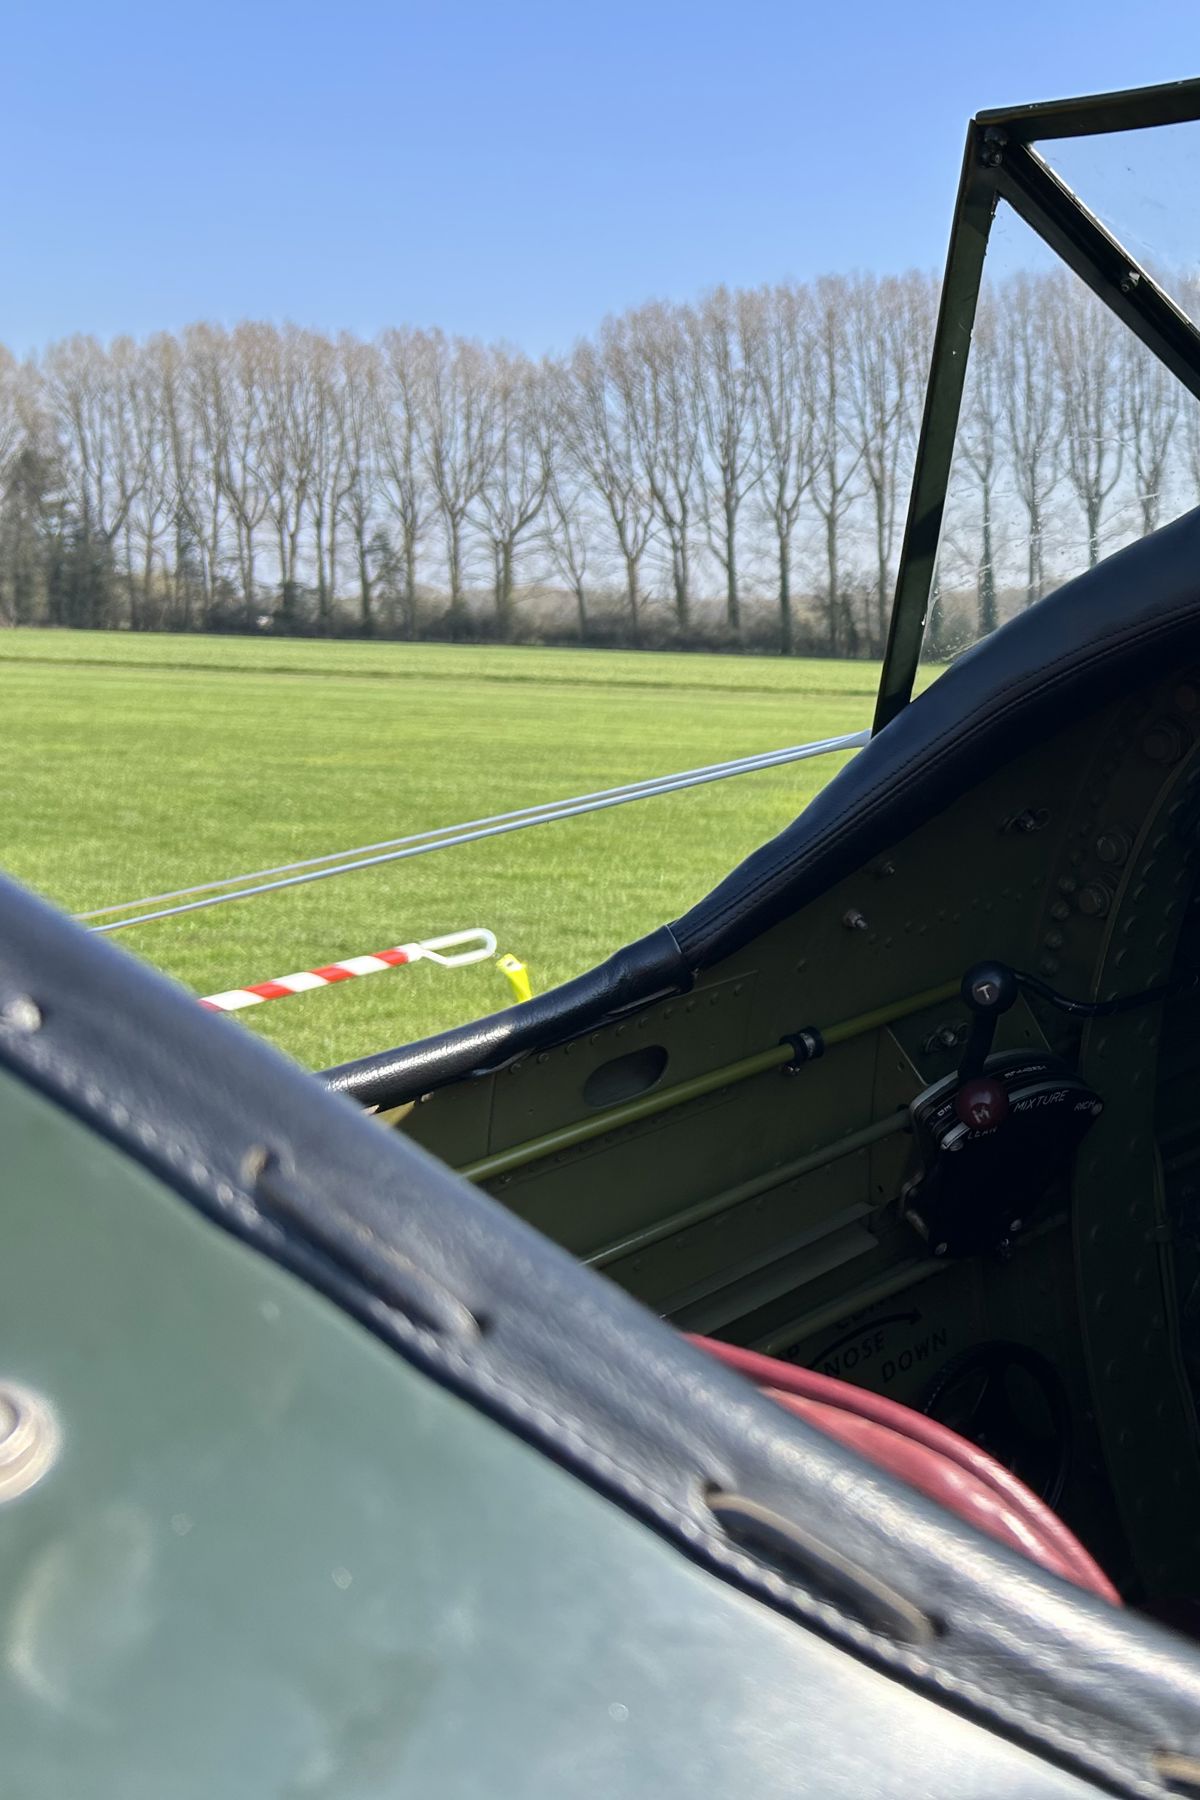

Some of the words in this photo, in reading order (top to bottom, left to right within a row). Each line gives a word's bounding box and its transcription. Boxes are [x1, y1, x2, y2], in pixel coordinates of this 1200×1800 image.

[976, 984, 991, 1001] T
[1013, 1089, 1070, 1112] MIXTURE
[825, 1331, 885, 1376] NOSE
[881, 1328, 948, 1383] DOWN
